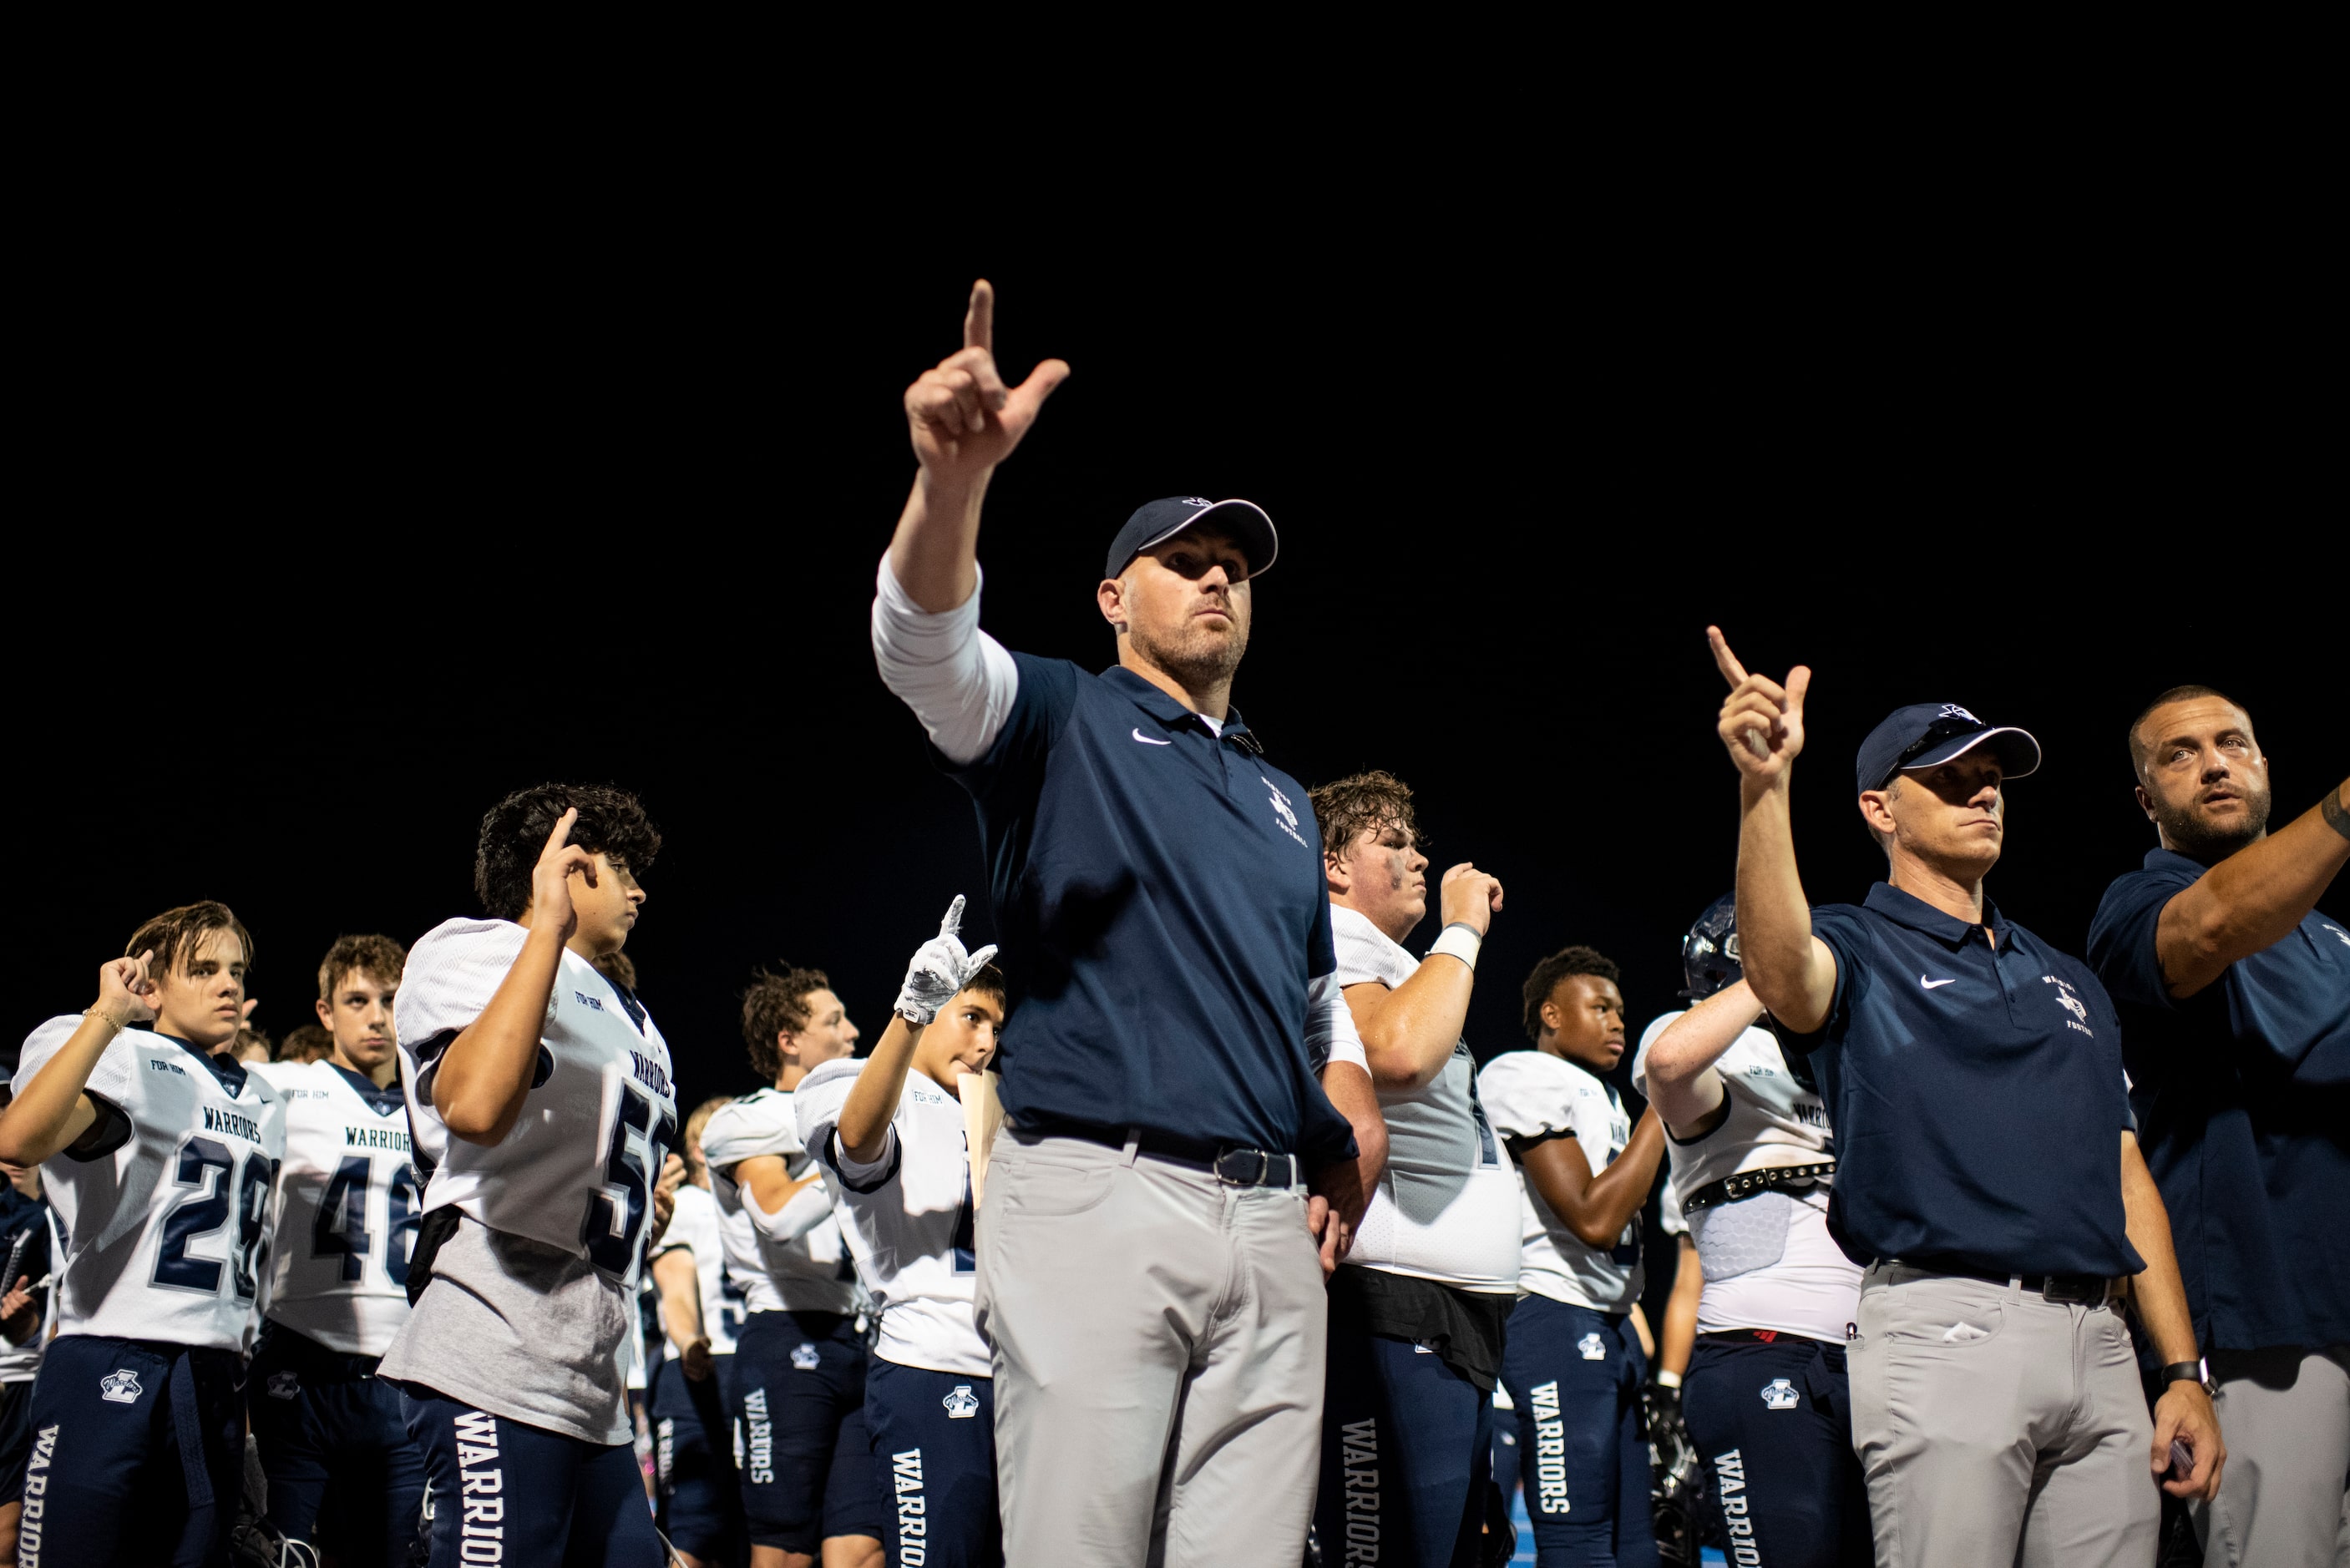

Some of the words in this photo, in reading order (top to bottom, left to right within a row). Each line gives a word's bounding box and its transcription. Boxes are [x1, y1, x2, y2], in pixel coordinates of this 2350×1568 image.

[150, 1060, 168, 1071] FOR
[170, 1063, 186, 1075] HIM
[629, 1050, 671, 1099] WARRIORS
[291, 1089, 308, 1099] FOR
[312, 1090, 329, 1100] HIM
[914, 1090, 927, 1102] FOR
[928, 1095, 943, 1105] HIM
[204, 1106, 261, 1145] WARRIORS
[1530, 1380, 1570, 1514] WARRIORS
[453, 1411, 504, 1568] WARRIO
[892, 1448, 926, 1568] WARRIO
[1714, 1449, 1763, 1568] WARRIO
